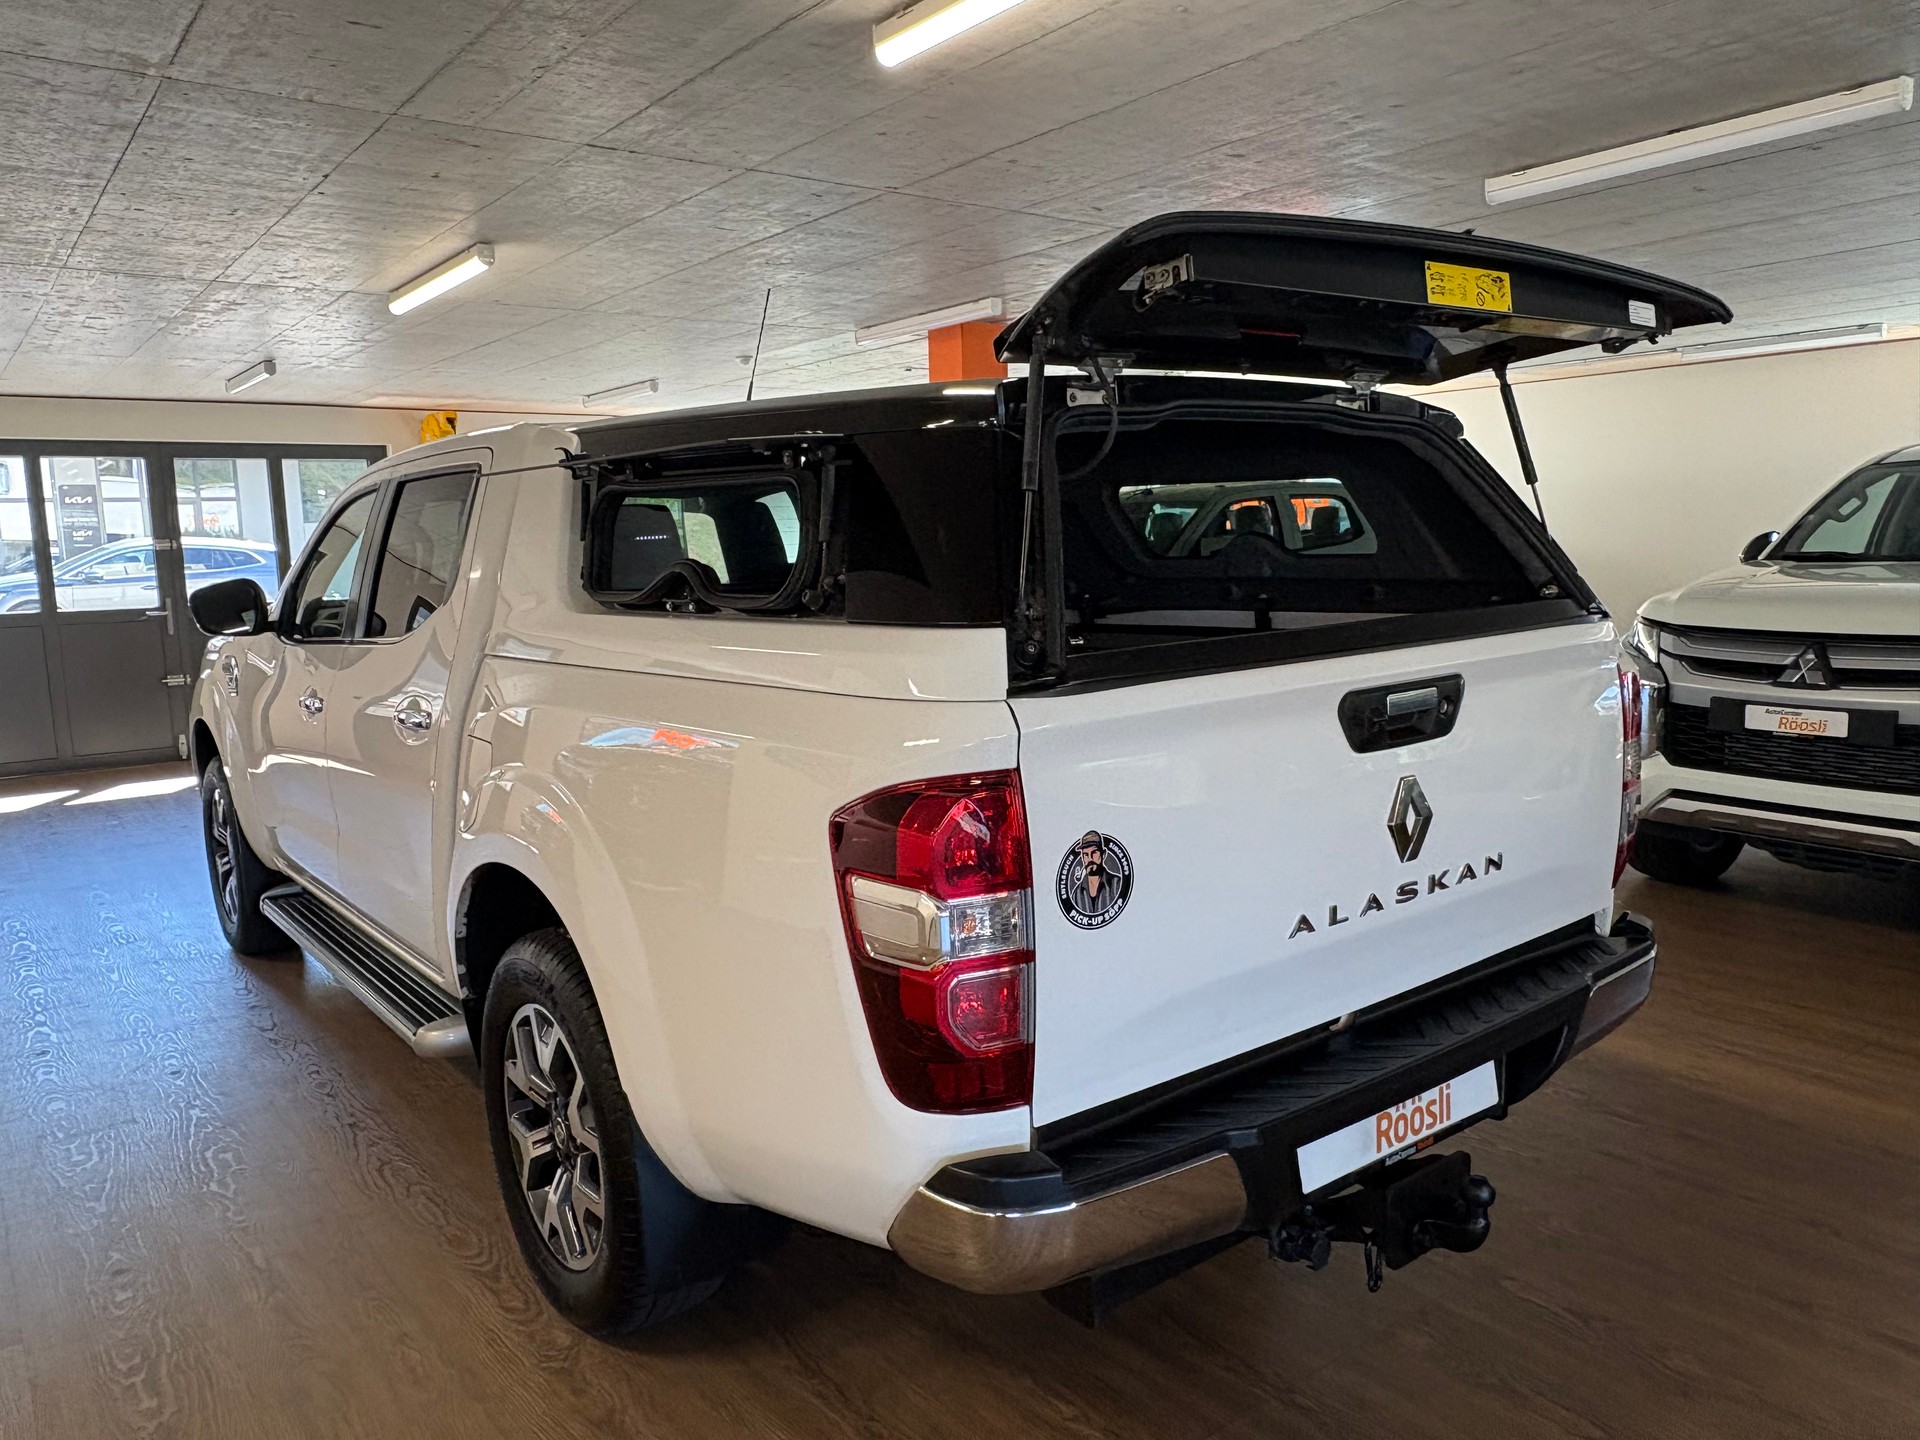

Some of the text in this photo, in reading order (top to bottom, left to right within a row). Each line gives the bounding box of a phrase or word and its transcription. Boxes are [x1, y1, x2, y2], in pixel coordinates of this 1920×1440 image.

[64, 496, 93, 504] KIA
[1778, 716, 1829, 733] Röösli
[1287, 851, 1504, 940] ALASKAN
[1069, 909, 1104, 926] PICK-UP
[1375, 1083, 1452, 1154] Röösli
